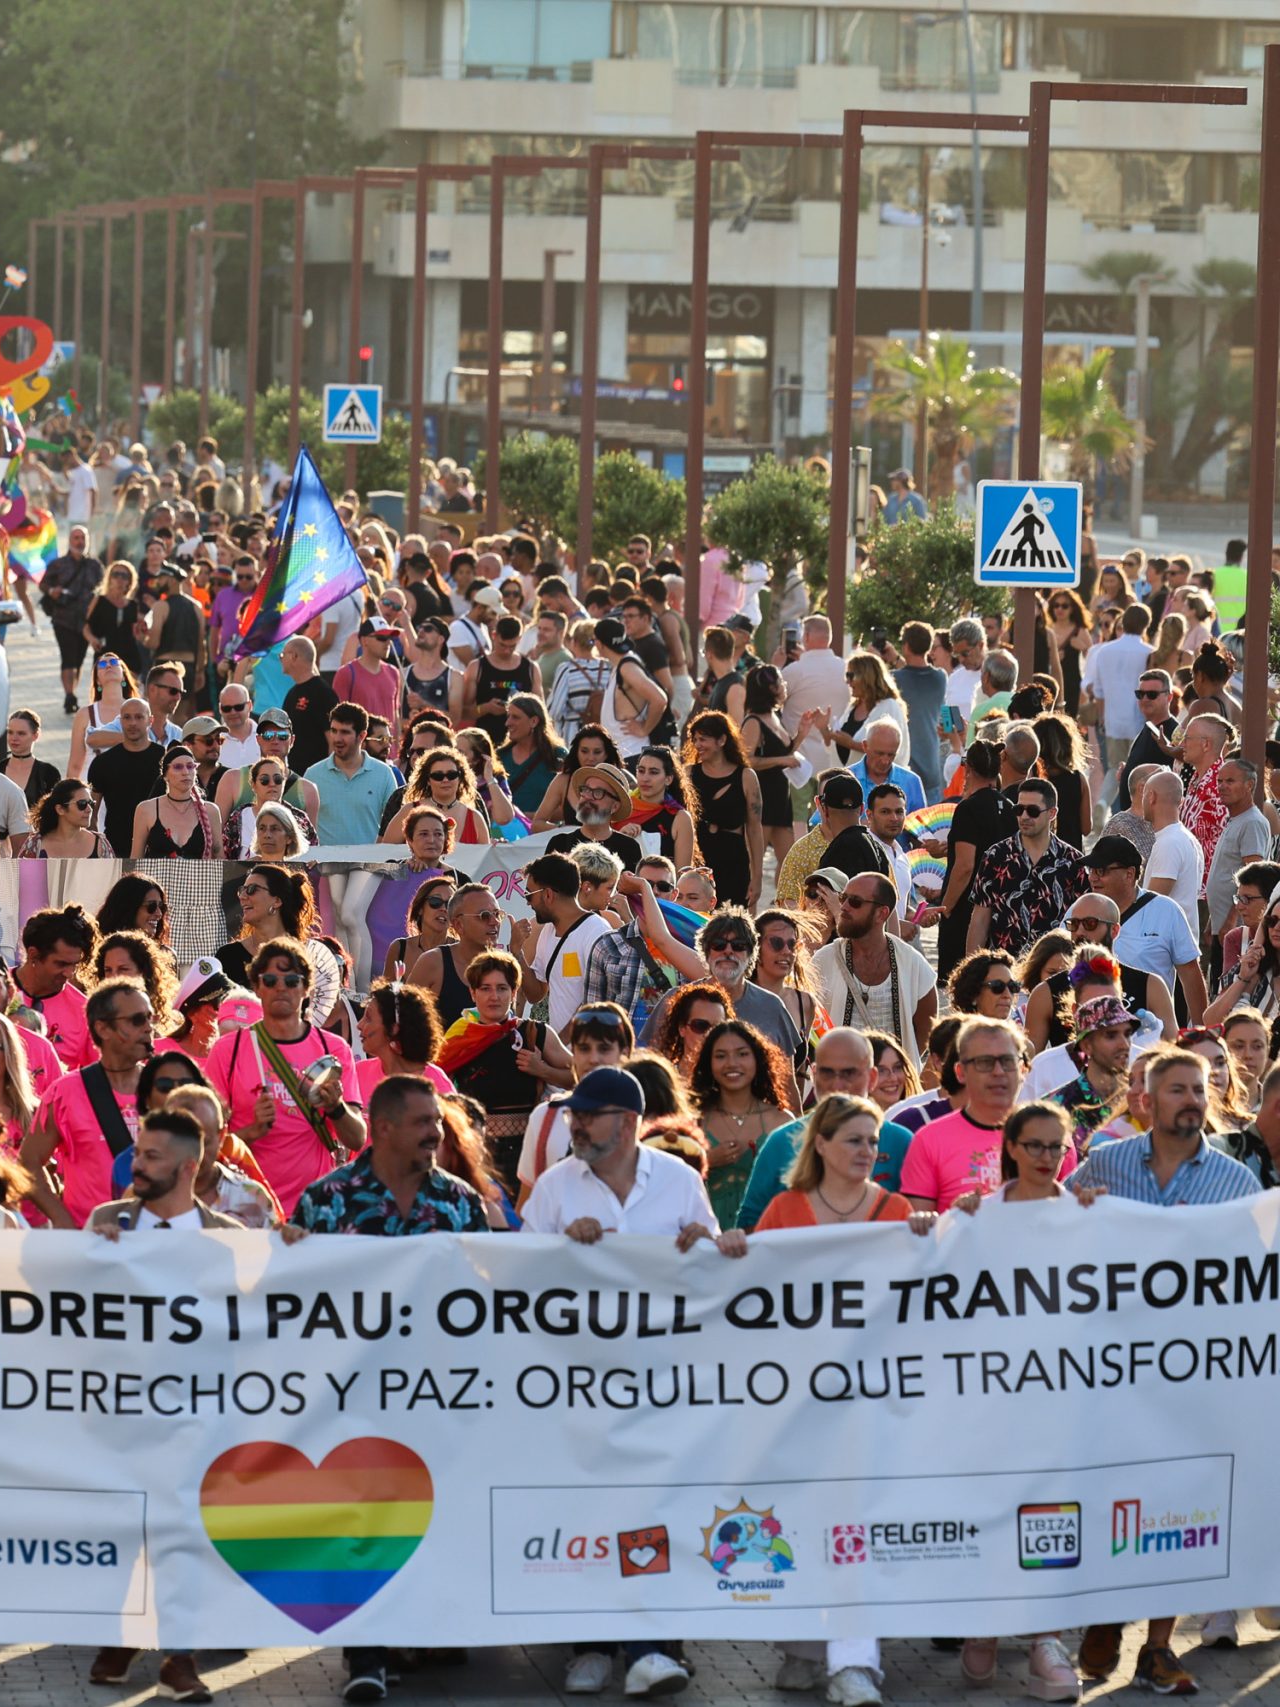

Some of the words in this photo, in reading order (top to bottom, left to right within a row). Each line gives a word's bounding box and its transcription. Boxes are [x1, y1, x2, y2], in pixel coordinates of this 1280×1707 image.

[0, 1290, 203, 1344] DRETS
[226, 1295, 240, 1341] I
[266, 1291, 413, 1341] PAU:
[437, 1288, 702, 1339] ORGULL
[724, 1281, 866, 1330] QUE
[889, 1253, 1280, 1324] TRANSFORM
[1, 1367, 307, 1416] DERECHOS
[326, 1371, 360, 1412] Y
[379, 1367, 496, 1411] PAZ:
[516, 1361, 790, 1410] ORGULLO
[809, 1355, 926, 1402] QUE
[942, 1333, 1278, 1396] TRANSFORM
[1025, 1518, 1076, 1532] IBIZA
[1142, 1515, 1156, 1529] sa
[1160, 1511, 1188, 1526] clau
[1191, 1507, 1205, 1523] de
[523, 1527, 610, 1560] alas
[871, 1521, 980, 1546] FELGTBI+
